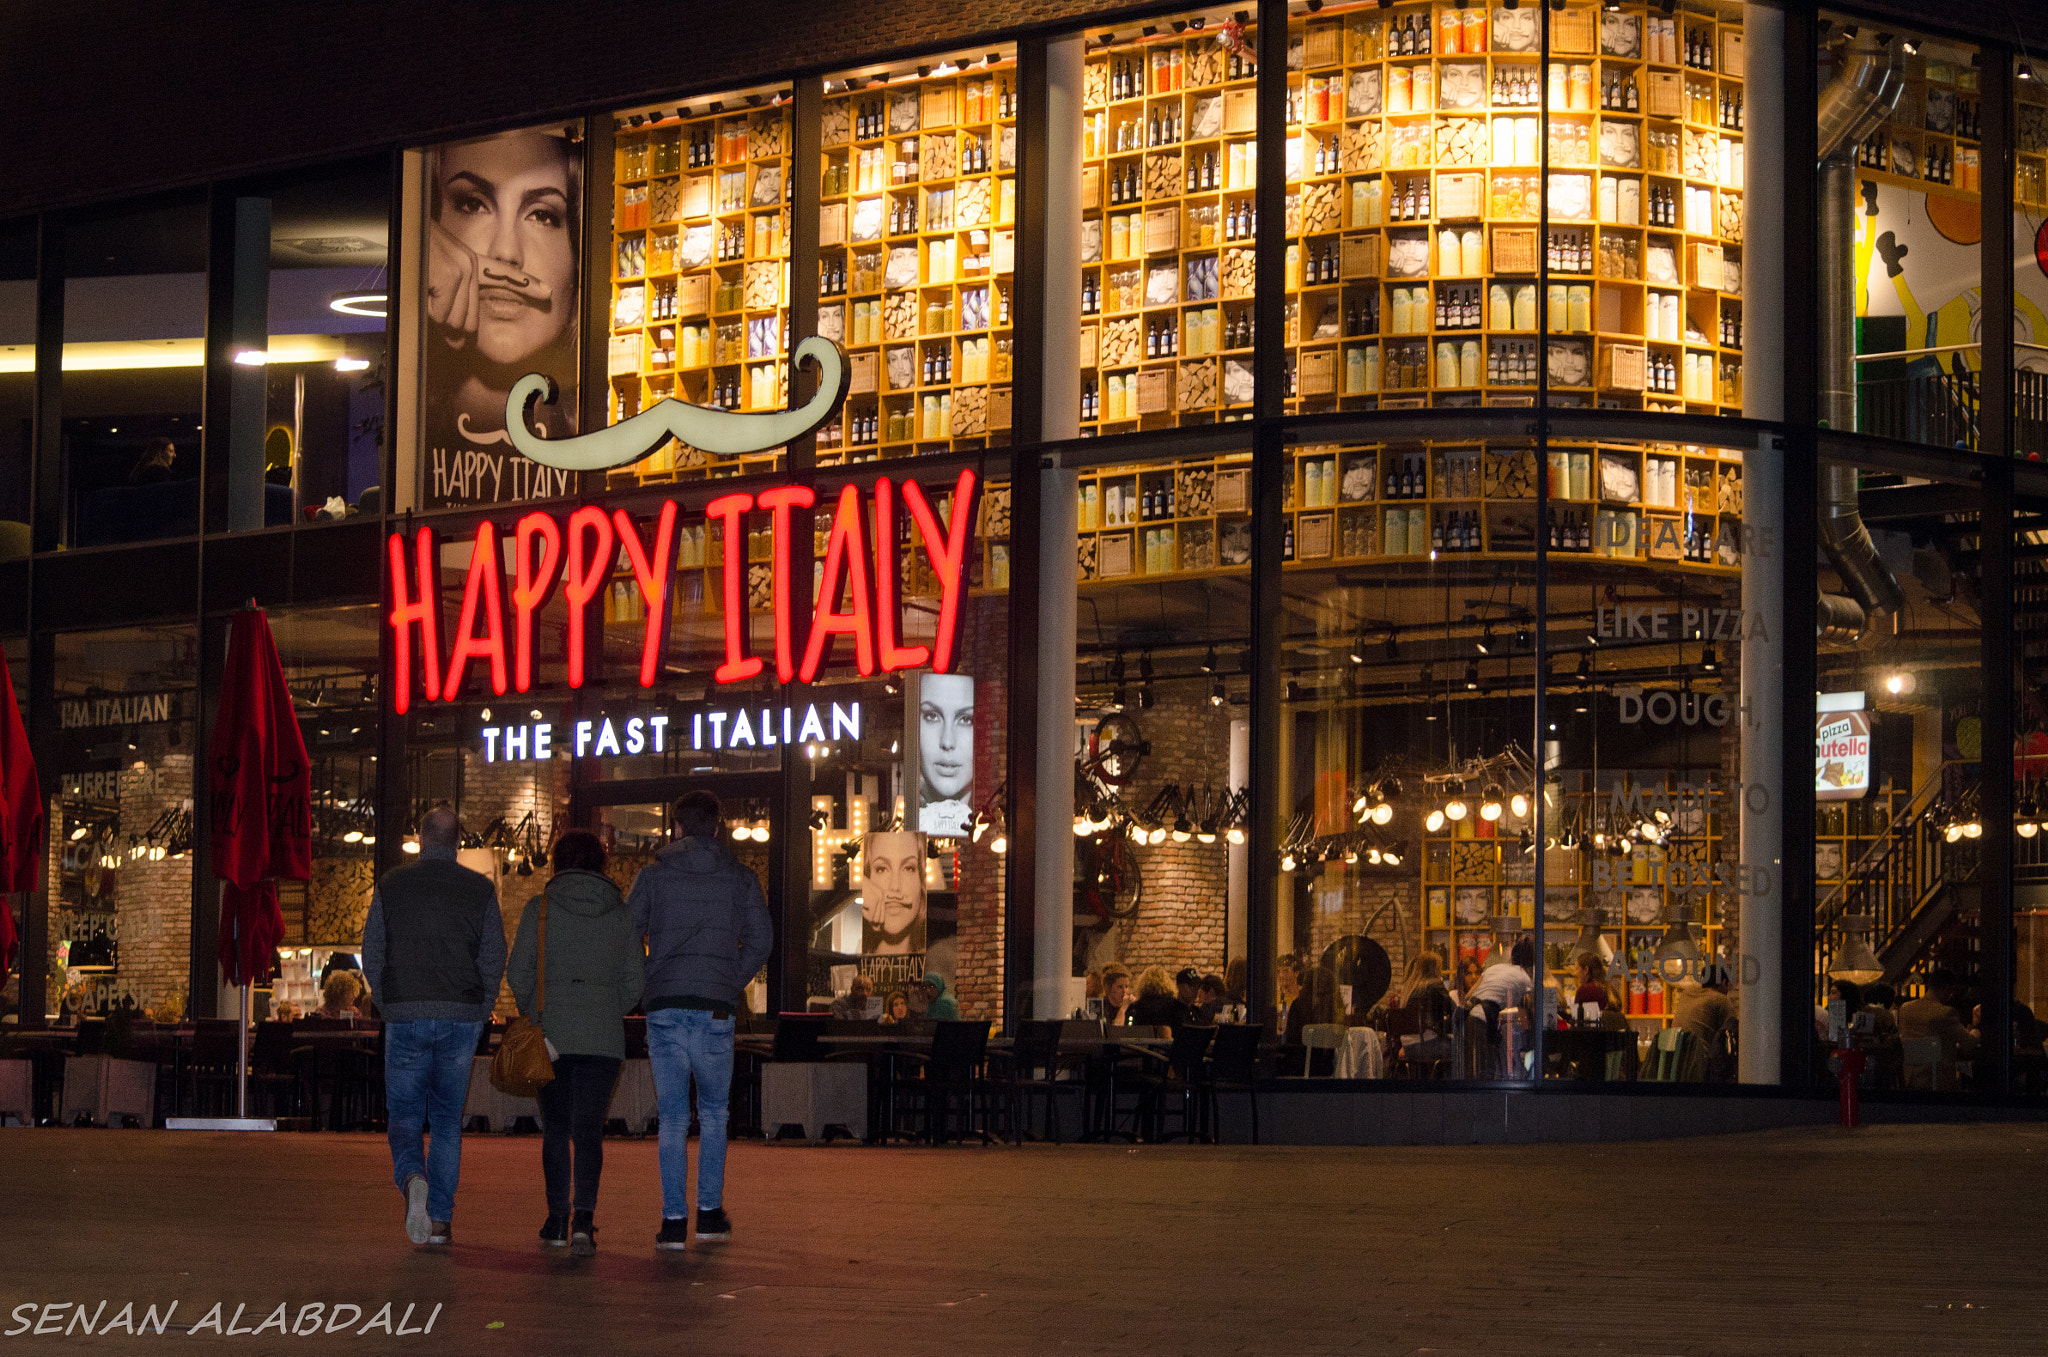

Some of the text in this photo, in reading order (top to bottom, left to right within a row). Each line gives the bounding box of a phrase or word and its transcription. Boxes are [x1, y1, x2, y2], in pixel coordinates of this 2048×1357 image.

[433, 448, 503, 502] HAPPY
[1594, 516, 1775, 558] IDEAS ARE
[389, 468, 975, 715] HAPPY ITALY
[1597, 606, 1769, 643] LIKE PIZZA
[61, 693, 168, 729] I'M ITALIAN
[482, 702, 860, 763] THE FAST ITALIAN
[1822, 721, 1849, 742] pizza
[1610, 781, 1770, 816] MADE TO
[1593, 859, 1771, 897] BE TOSSED
[57, 914, 100, 943] KEEP
[861, 955, 926, 983] HAPPY ITALY
[1605, 949, 1760, 987] AROUND
